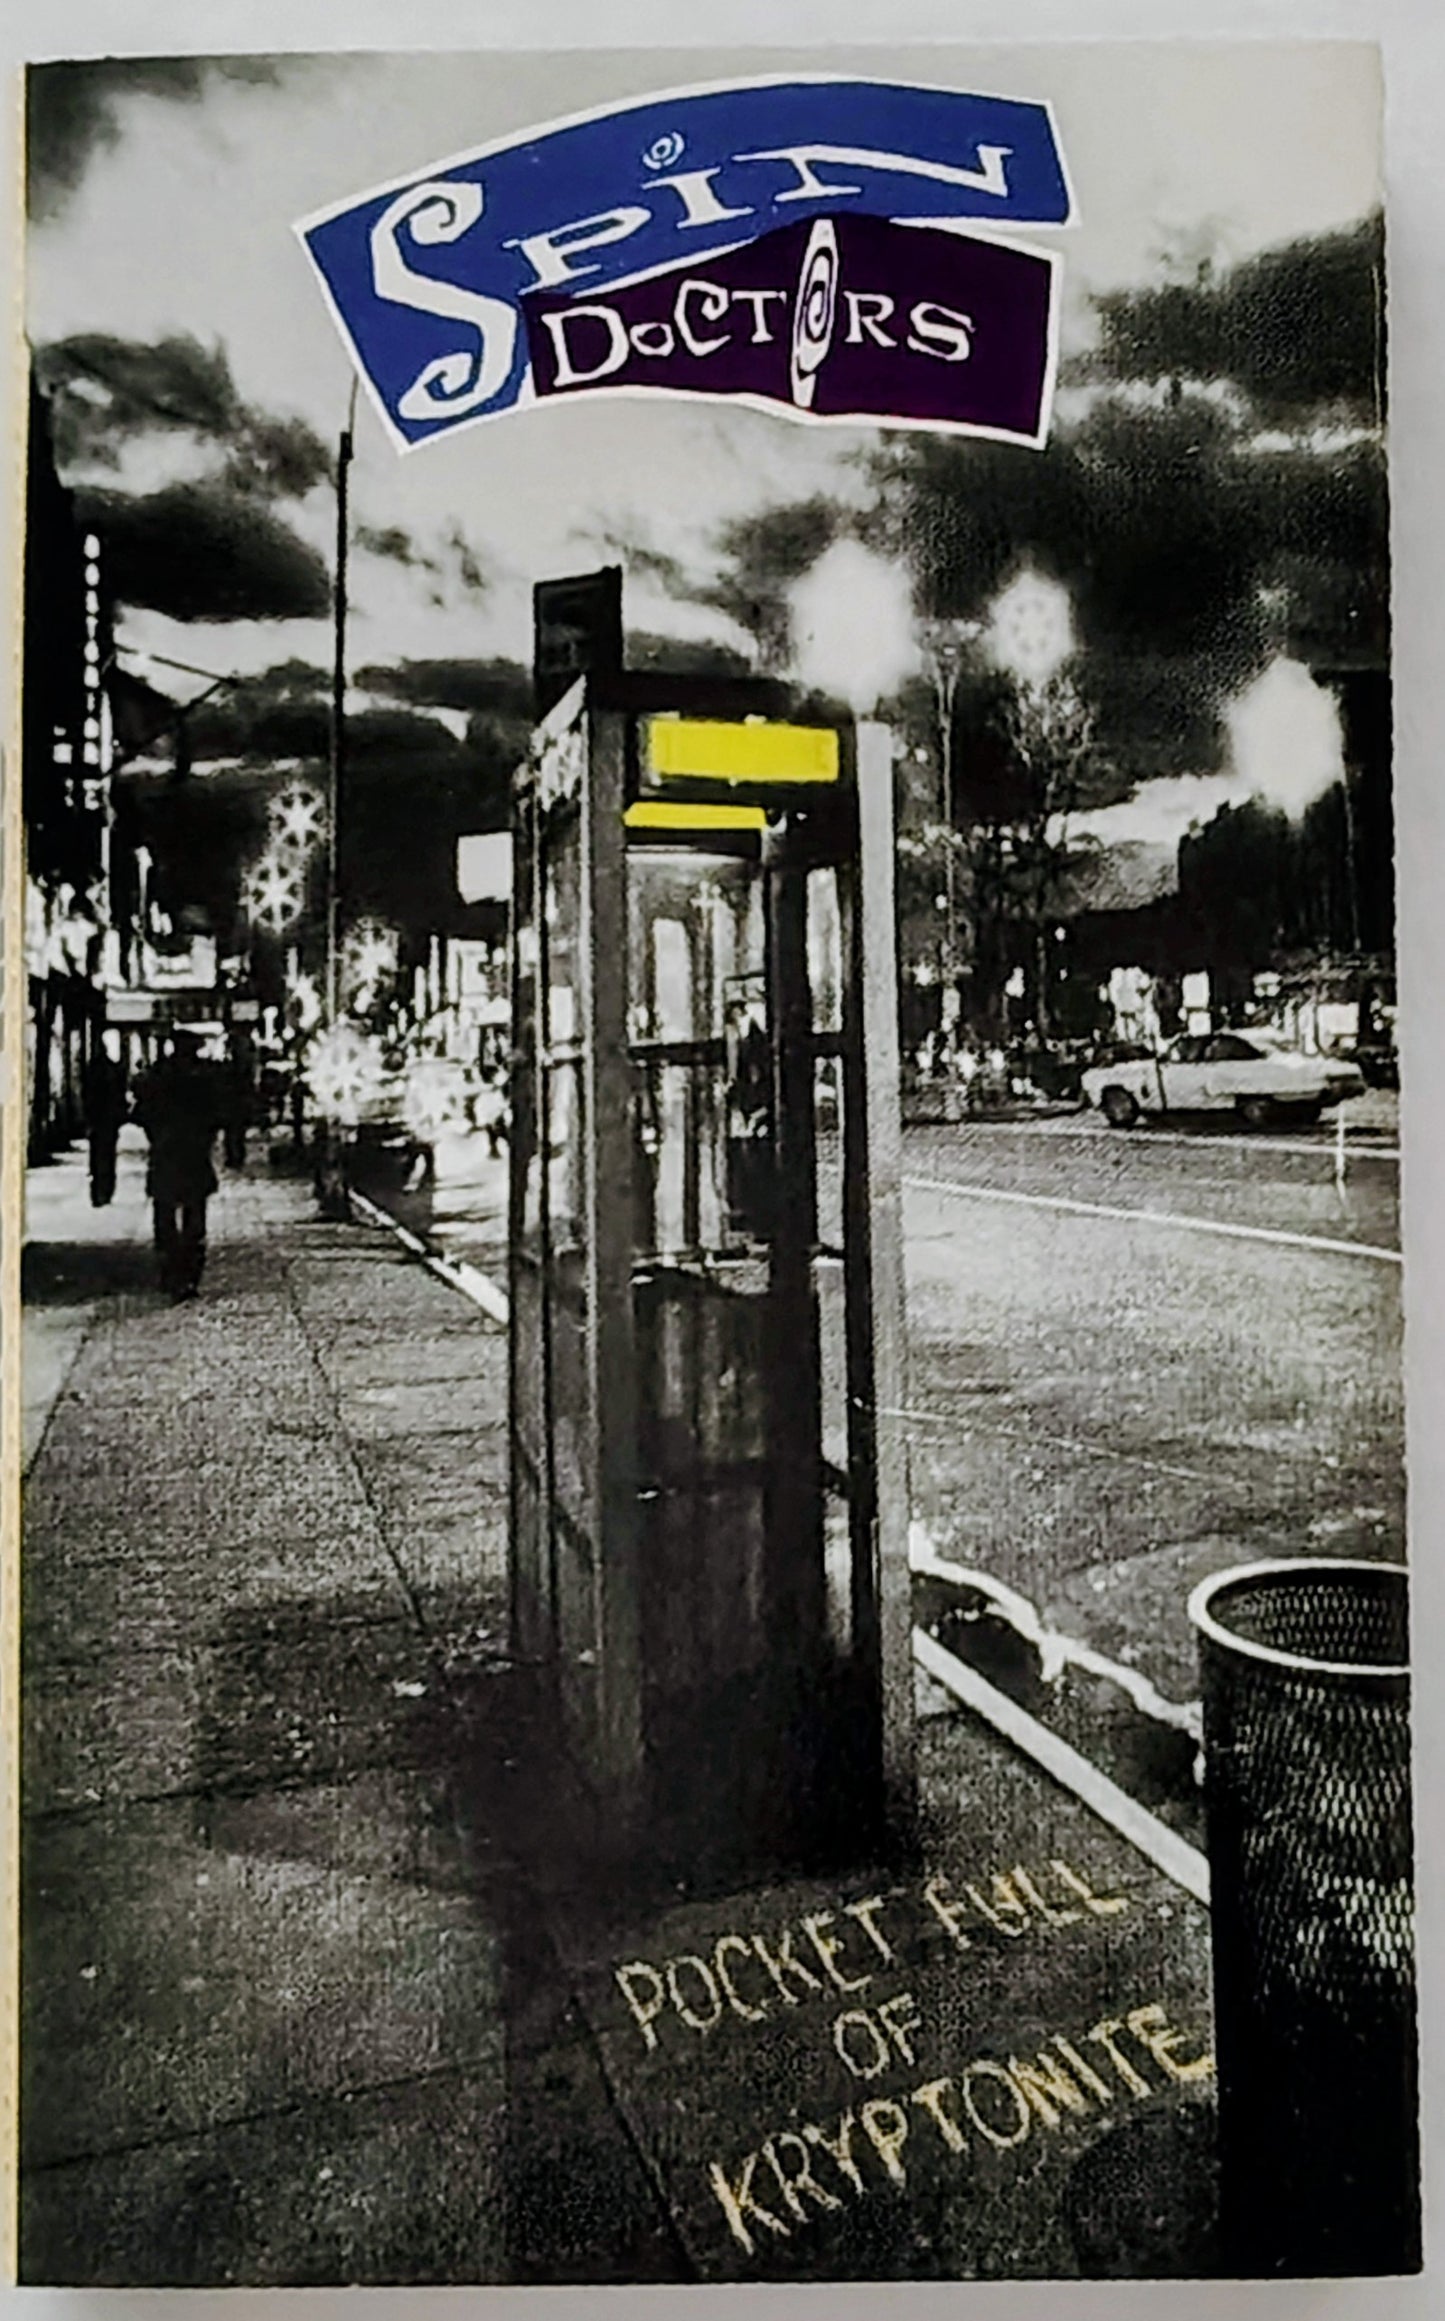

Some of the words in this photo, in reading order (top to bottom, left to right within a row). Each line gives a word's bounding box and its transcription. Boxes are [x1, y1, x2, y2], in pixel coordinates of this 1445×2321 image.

[615, 1896, 893, 2051] POCKET
[925, 1859, 1129, 1950] FULL
[832, 1994, 922, 2081] OF
[709, 2003, 1218, 2256] KRYPTONITE
